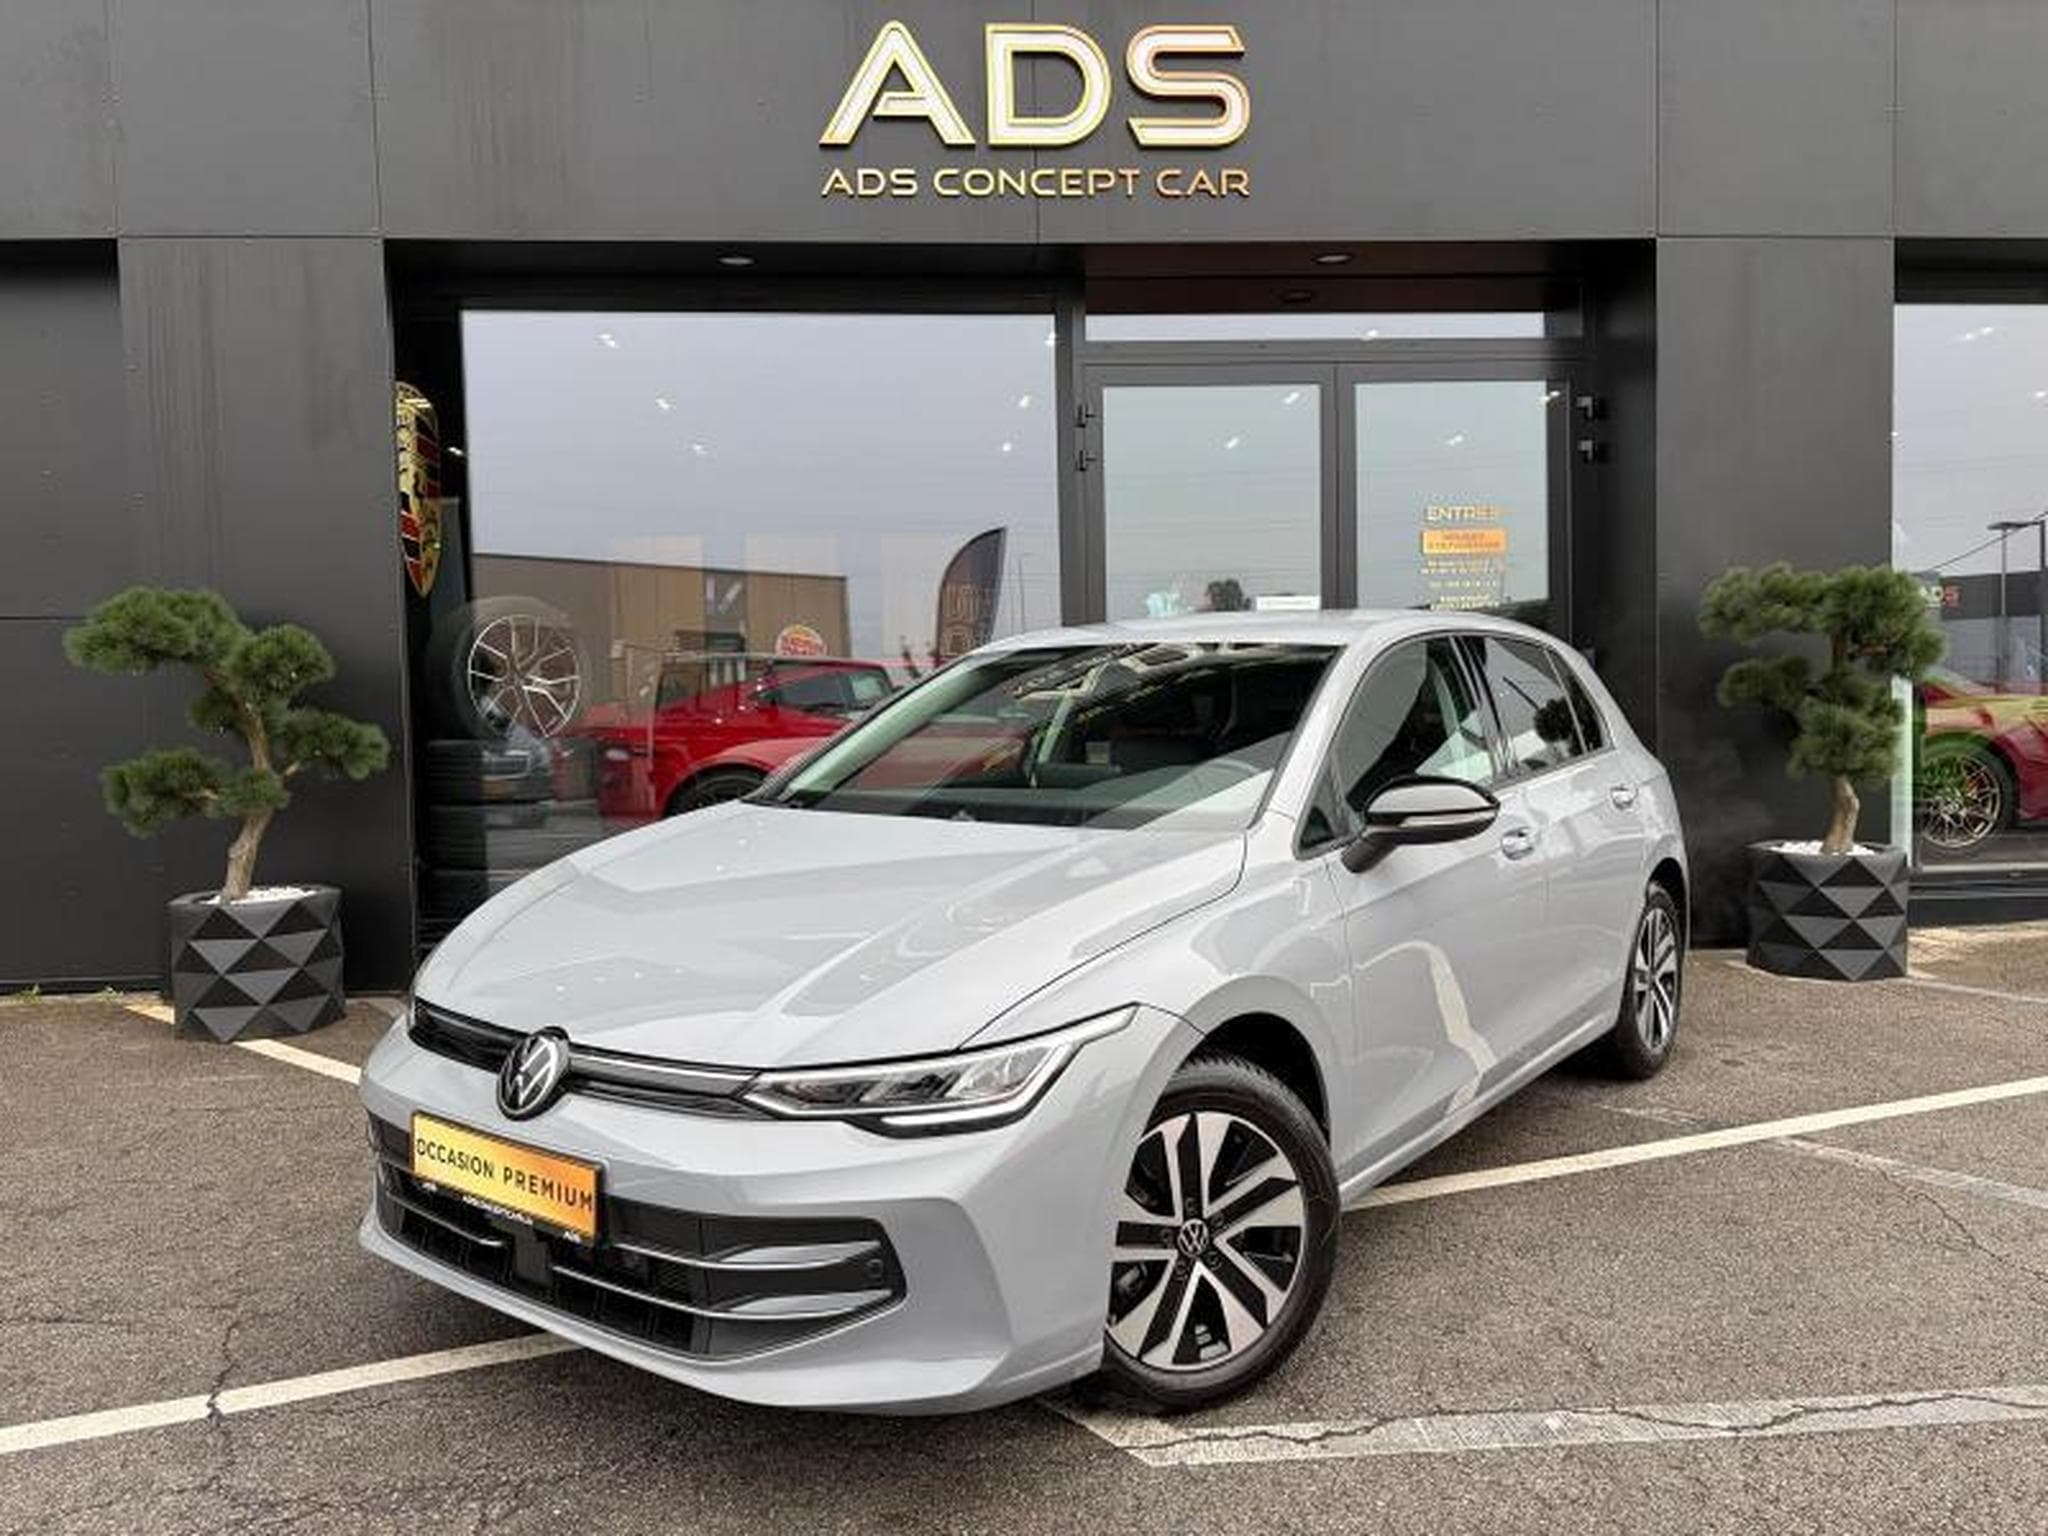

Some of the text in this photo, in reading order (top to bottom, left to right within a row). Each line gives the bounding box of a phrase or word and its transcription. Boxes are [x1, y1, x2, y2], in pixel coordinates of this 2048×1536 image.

[819, 19, 1251, 148] ADS
[821, 168, 1250, 197] ADS CONCEPT CAR
[416, 1138, 495, 1179] OCCASION
[503, 1166, 593, 1212] PREMIUM
